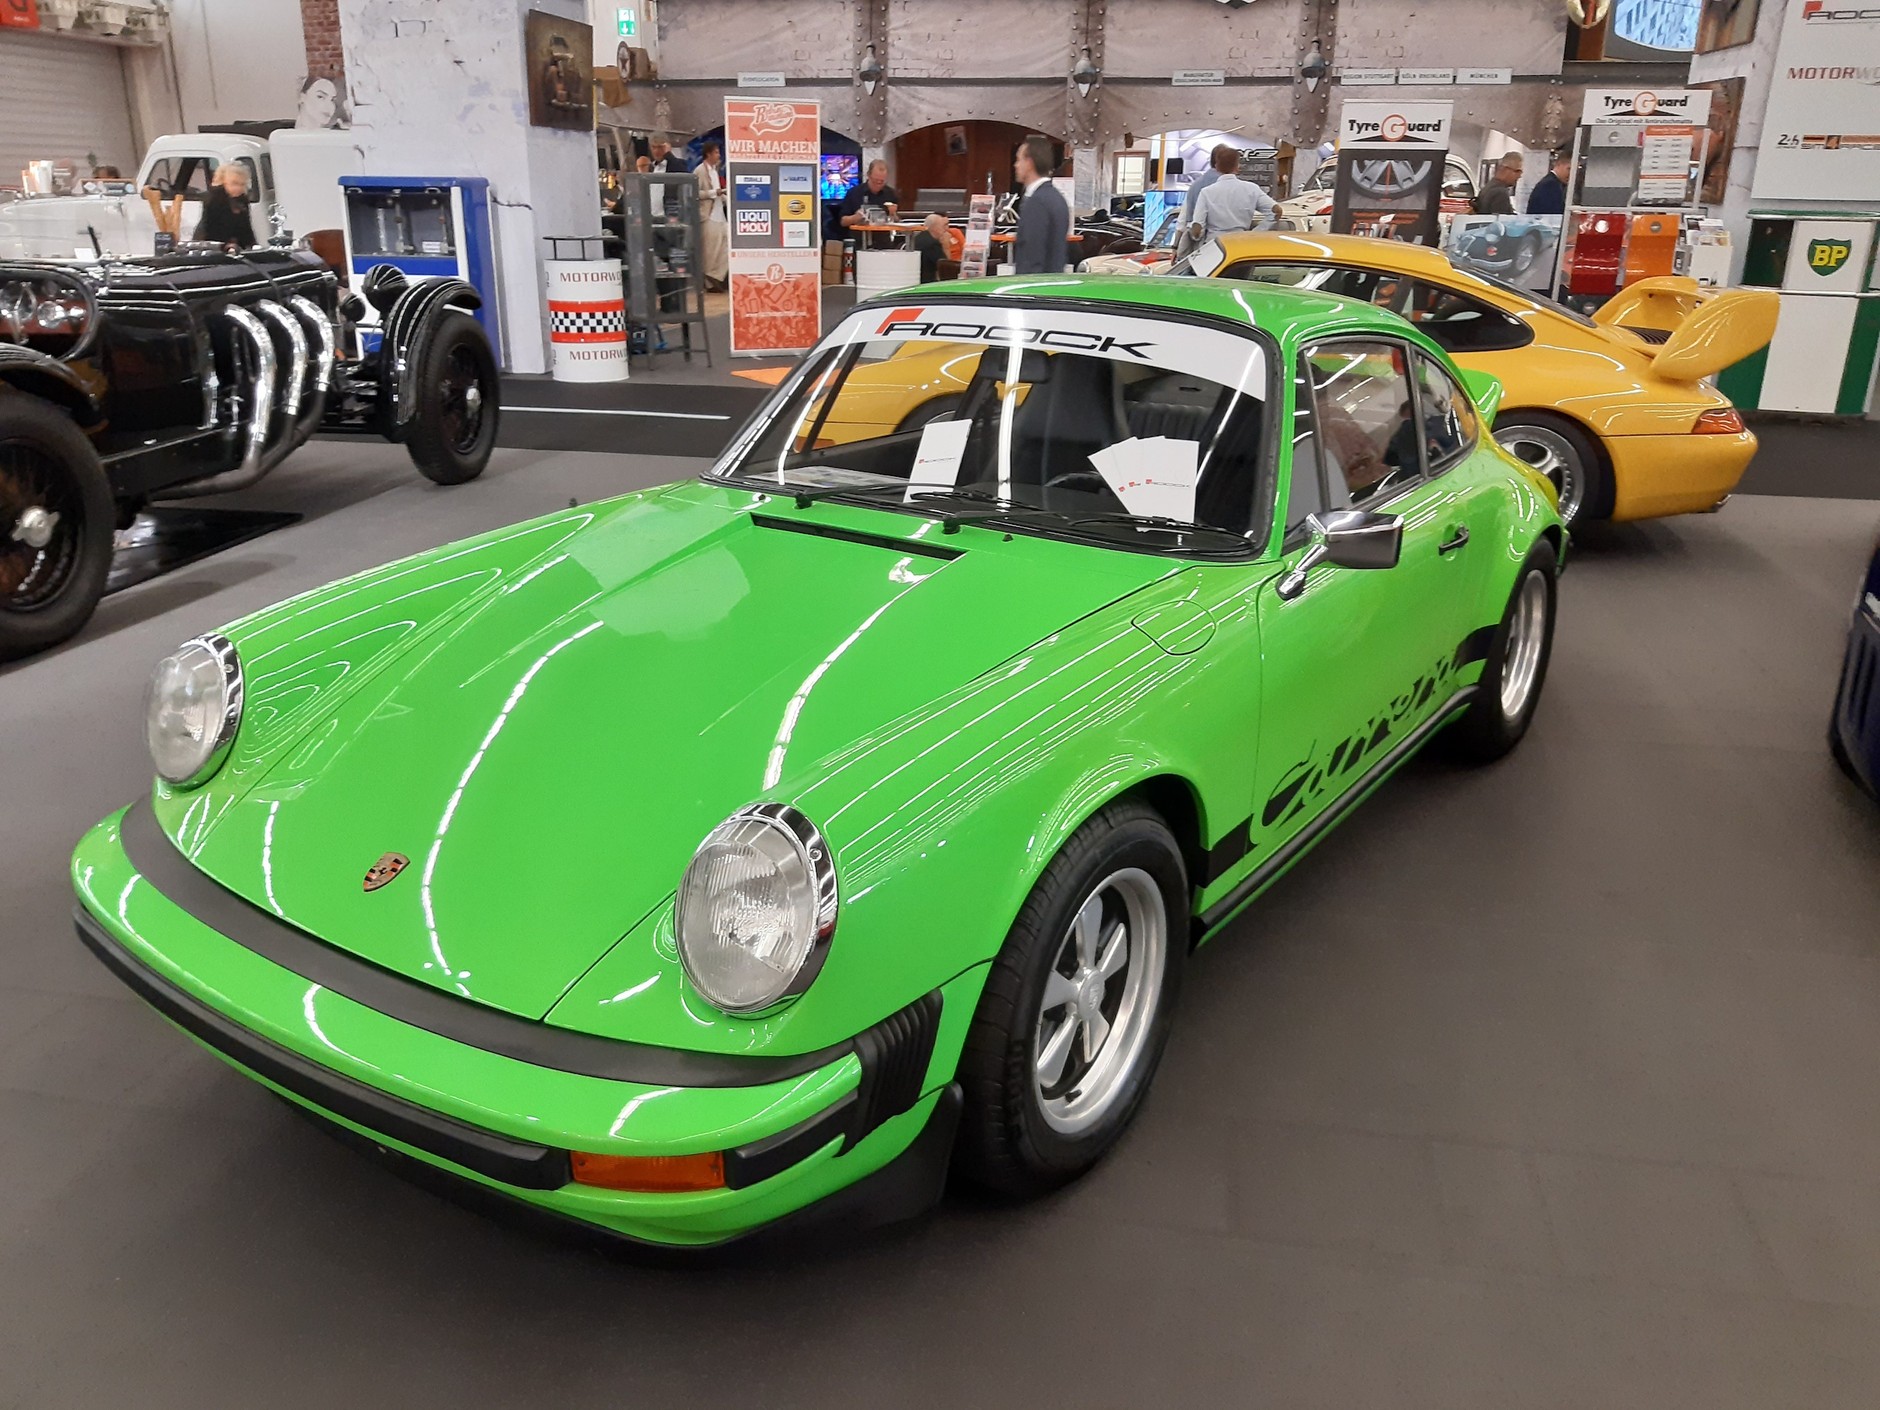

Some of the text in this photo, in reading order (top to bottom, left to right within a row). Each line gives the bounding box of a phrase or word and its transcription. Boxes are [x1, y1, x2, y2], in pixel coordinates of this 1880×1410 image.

[729, 140, 818, 154] WIR MACHEN
[740, 212, 768, 222] LIQUI
[740, 222, 769, 233] MOLY
[1811, 244, 1848, 267] BP
[880, 322, 1158, 360] ROOCK
